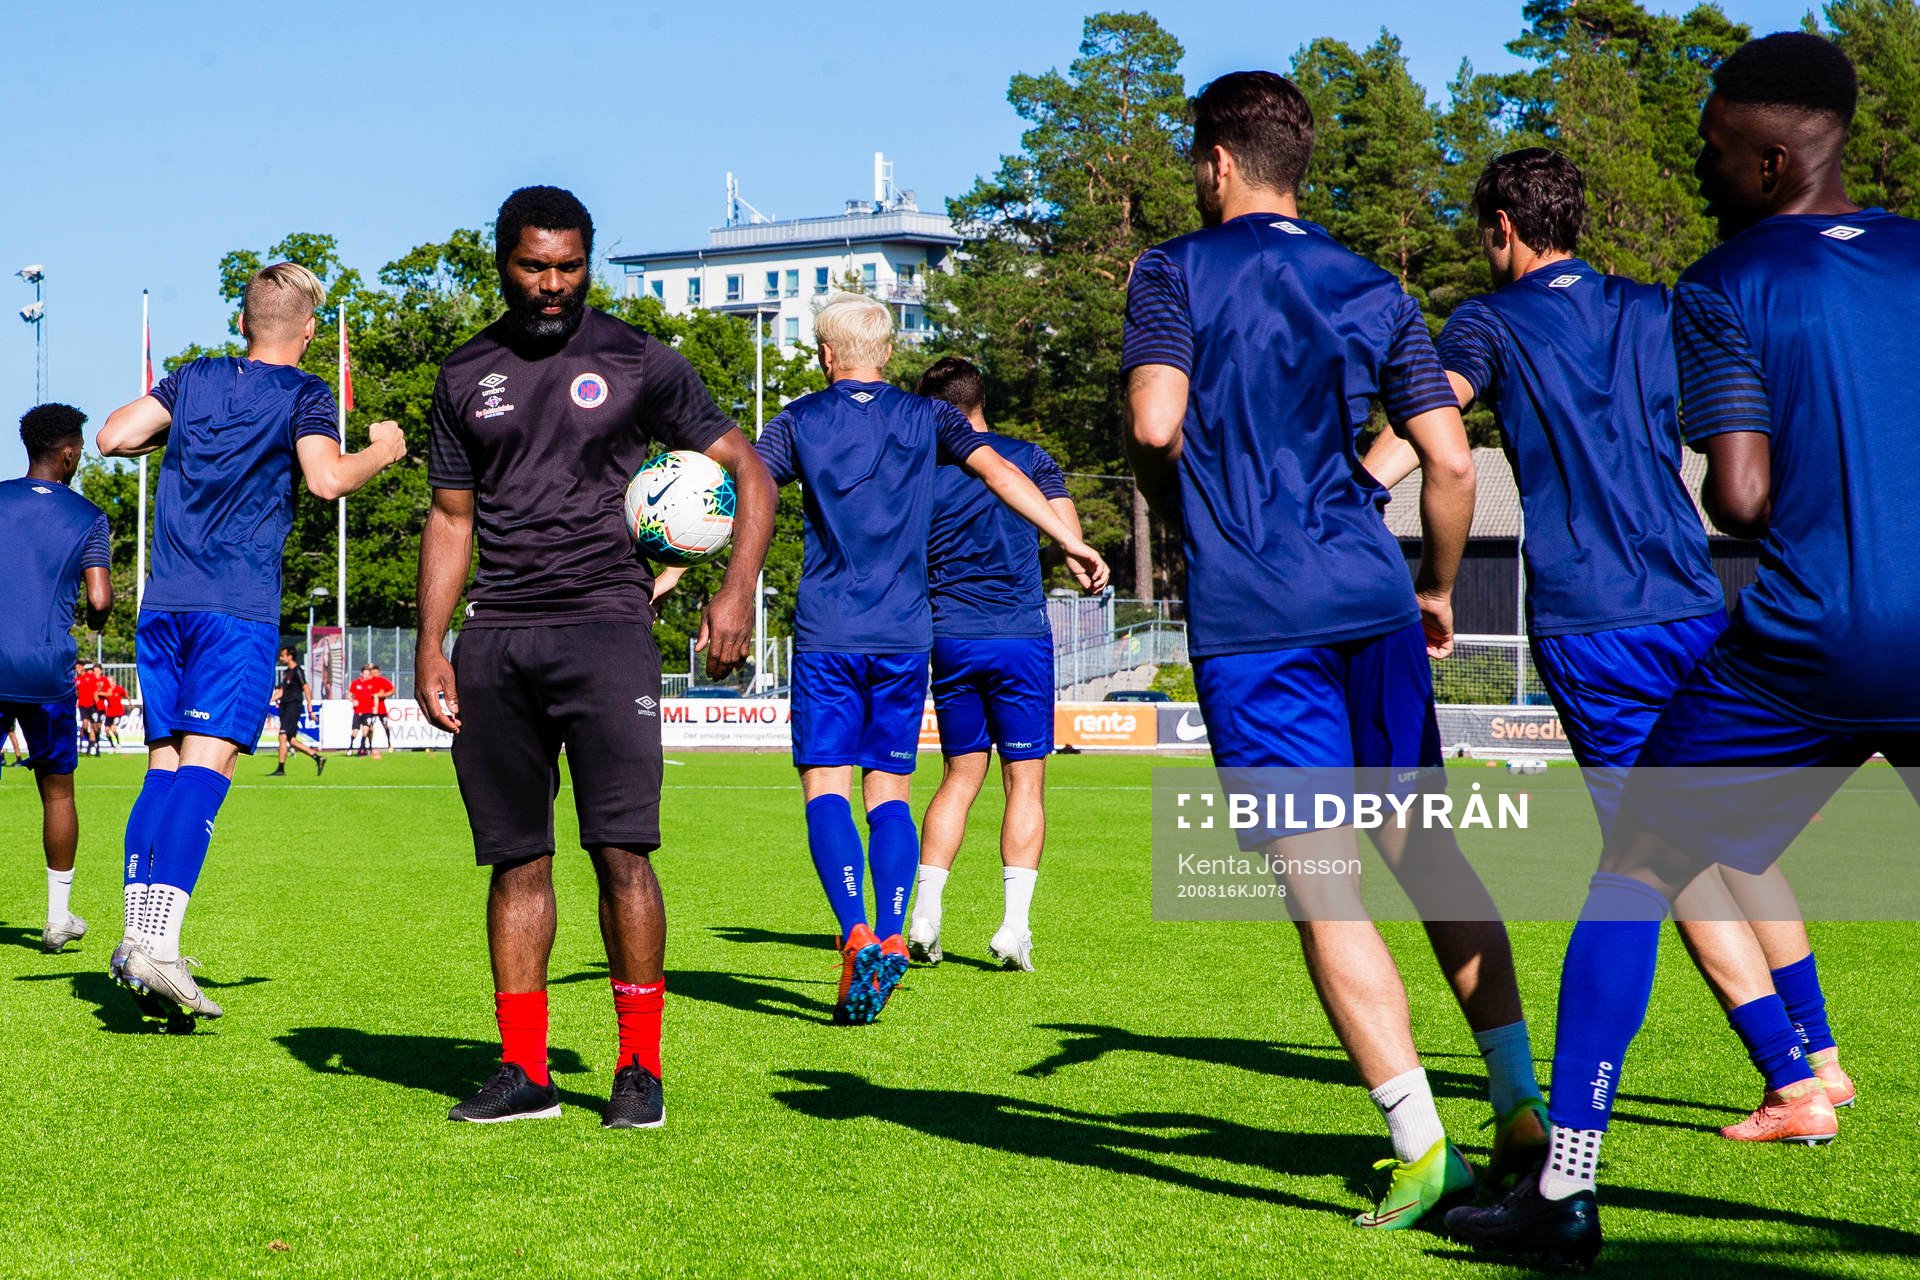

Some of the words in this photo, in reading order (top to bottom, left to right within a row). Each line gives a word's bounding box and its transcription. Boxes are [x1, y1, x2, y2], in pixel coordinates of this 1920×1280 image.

[482, 387, 506, 397] umbro
[663, 706, 698, 724] ML
[706, 706, 777, 724] DEMO
[1073, 711, 1137, 733] renta
[390, 725, 453, 740] MANA
[1005, 740, 1032, 749] umbro
[843, 865, 858, 897] umbro
[892, 886, 905, 915] umbro
[1591, 1061, 1613, 1111] umbro
